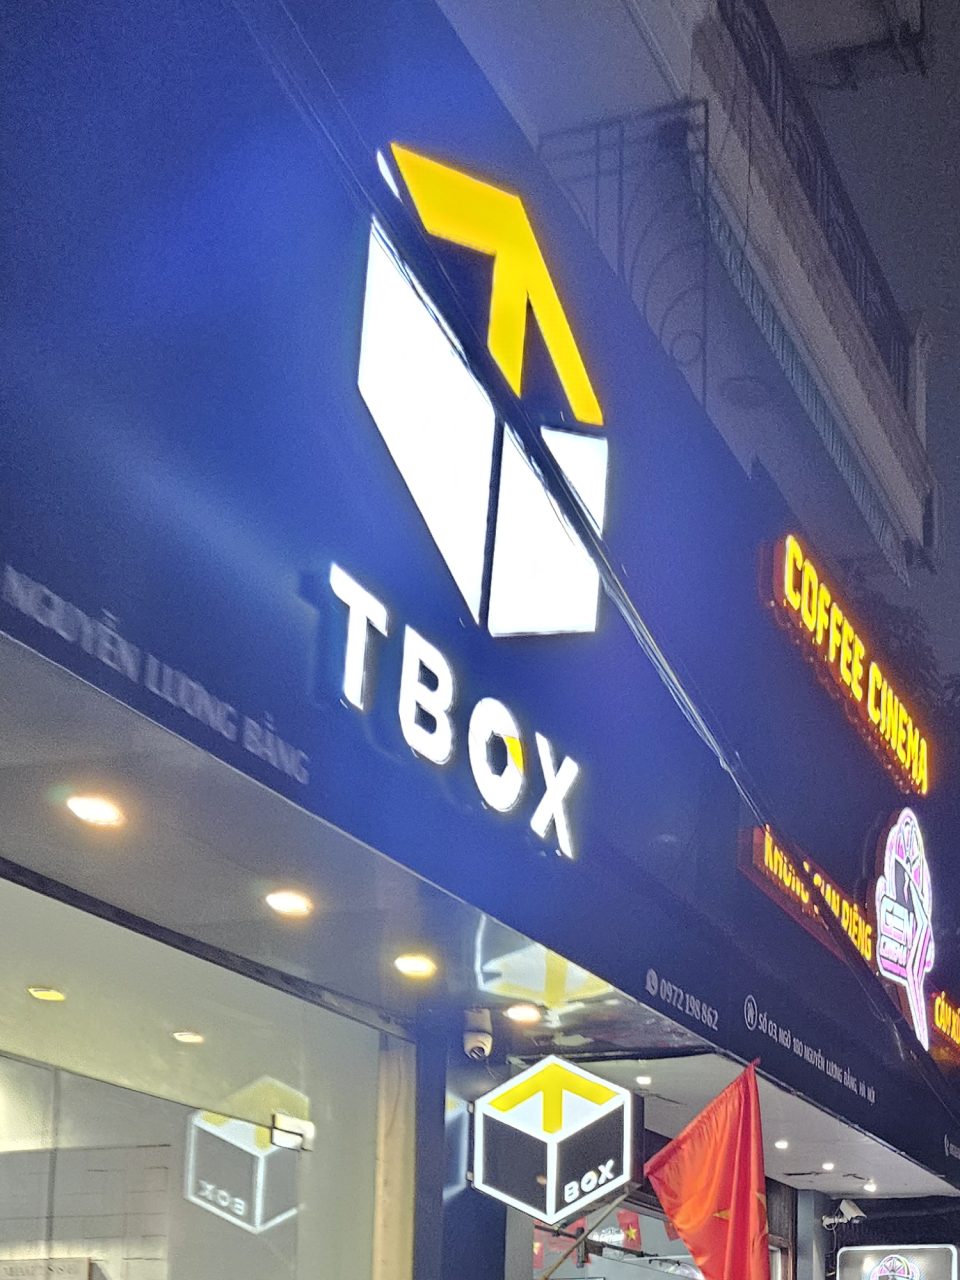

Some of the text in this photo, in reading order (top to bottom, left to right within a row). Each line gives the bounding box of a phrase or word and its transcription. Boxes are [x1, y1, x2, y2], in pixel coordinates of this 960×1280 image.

[329, 560, 579, 859] TBOX
[785, 534, 928, 795] COFFEE CINEMA
[660, 978, 719, 1032] 0972 198 862
[564, 1159, 616, 1204] BOX
